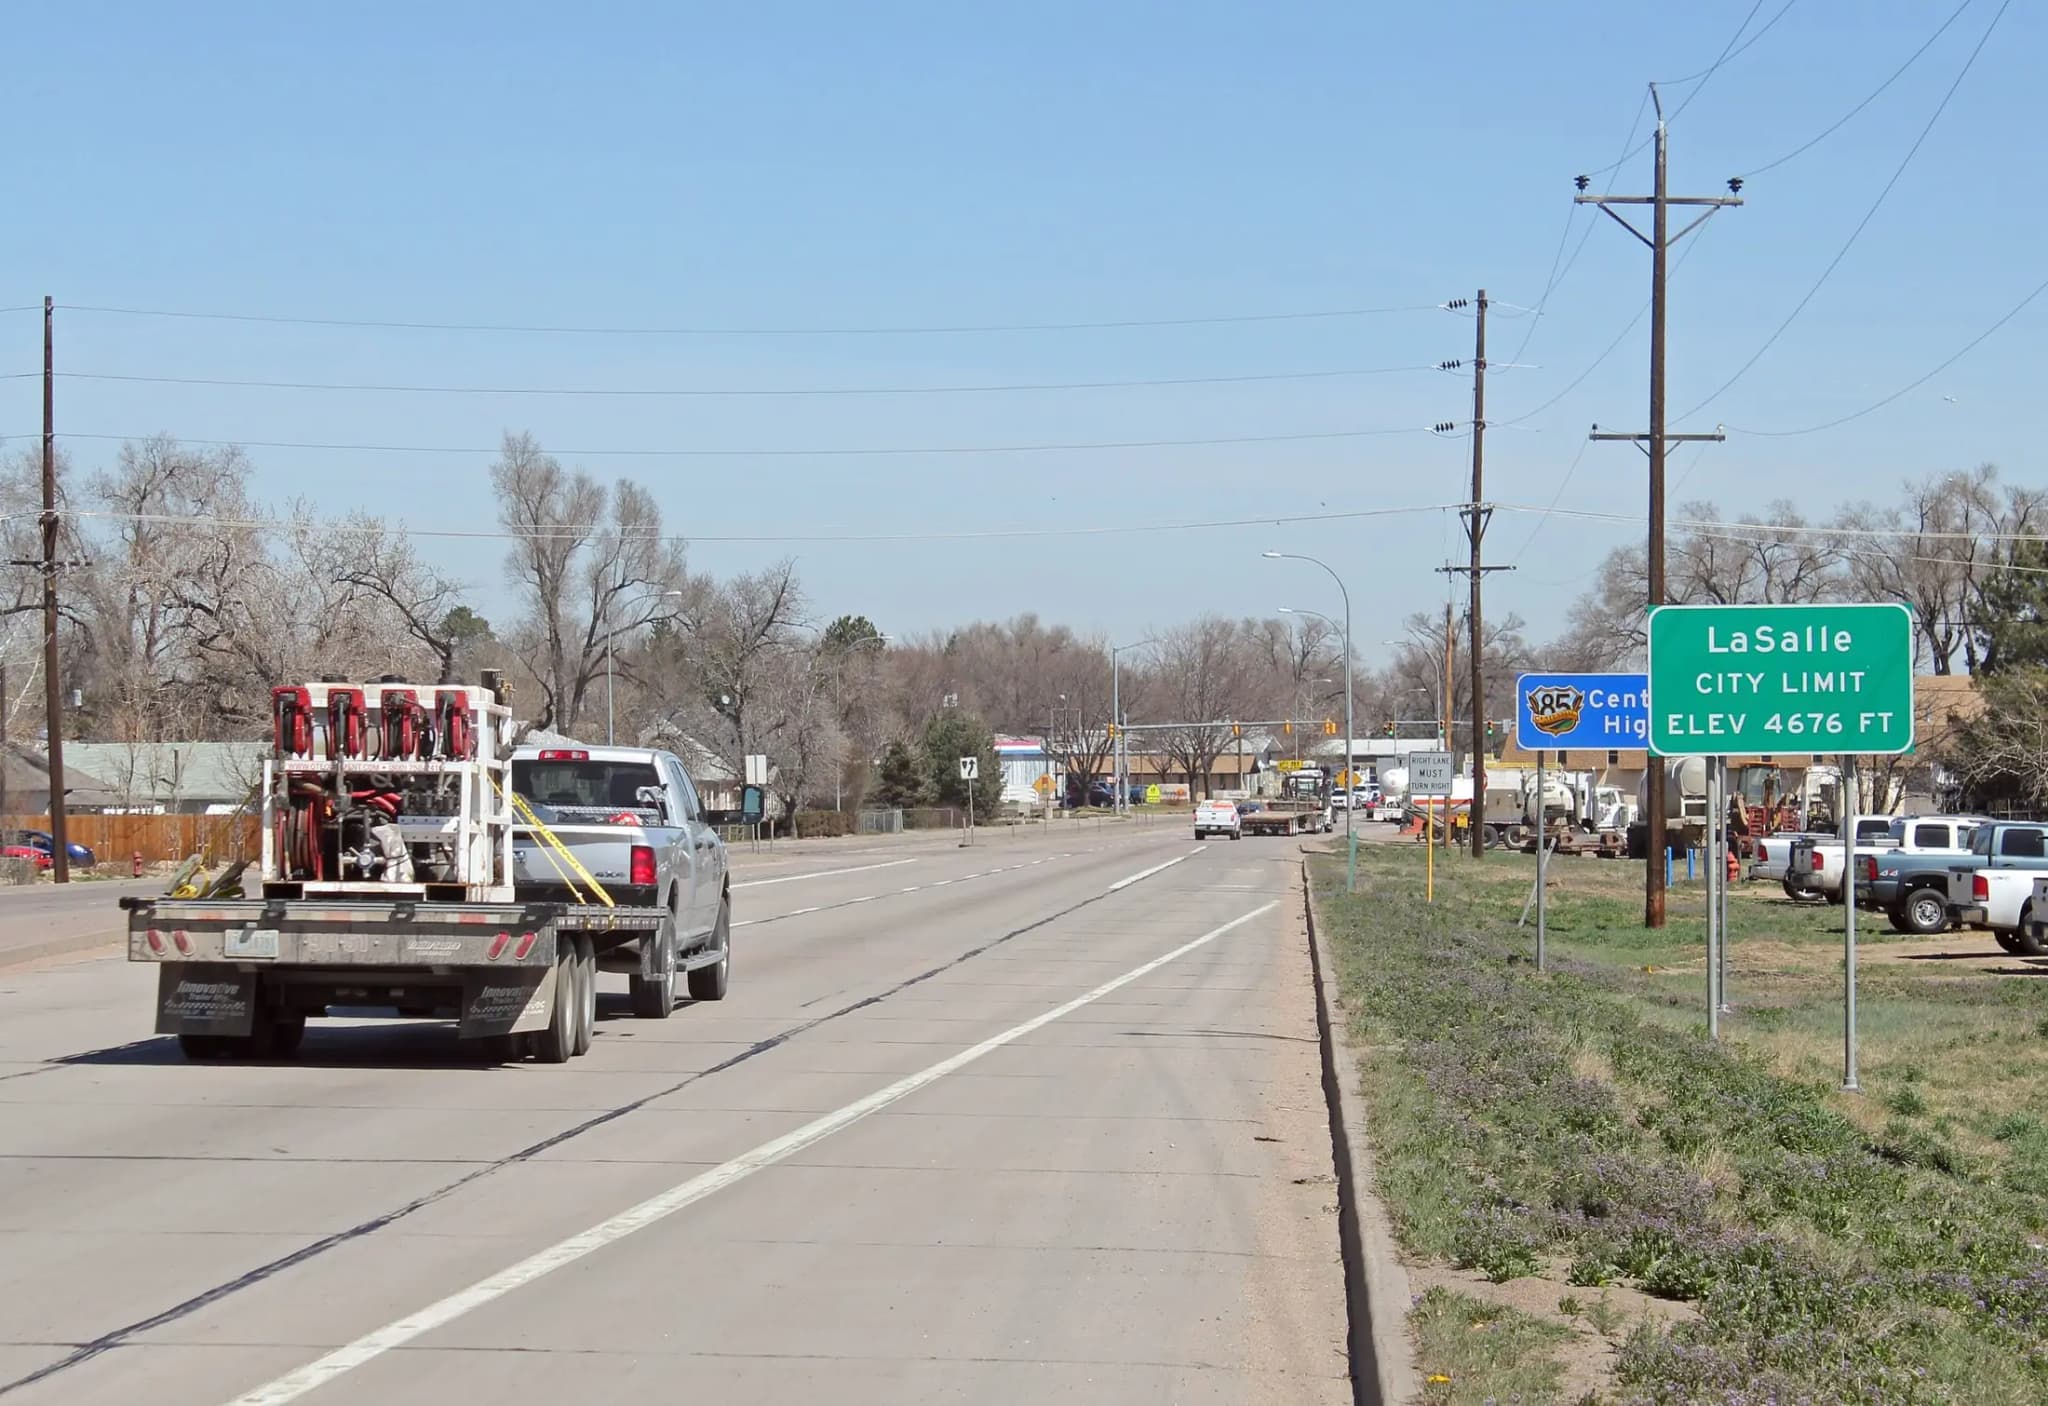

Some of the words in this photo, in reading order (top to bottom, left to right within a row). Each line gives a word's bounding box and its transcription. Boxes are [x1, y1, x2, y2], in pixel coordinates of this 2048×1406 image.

[1708, 626, 1853, 654] LaSalle
[1695, 672, 1765, 694] CITY
[1782, 671, 1865, 693] LIMIT
[1540, 693, 1571, 716] 85
[1667, 713, 1747, 735] ELEV
[1764, 712, 1843, 734] 4676
[1859, 712, 1894, 733] FT
[1419, 769, 1443, 777] MUST
